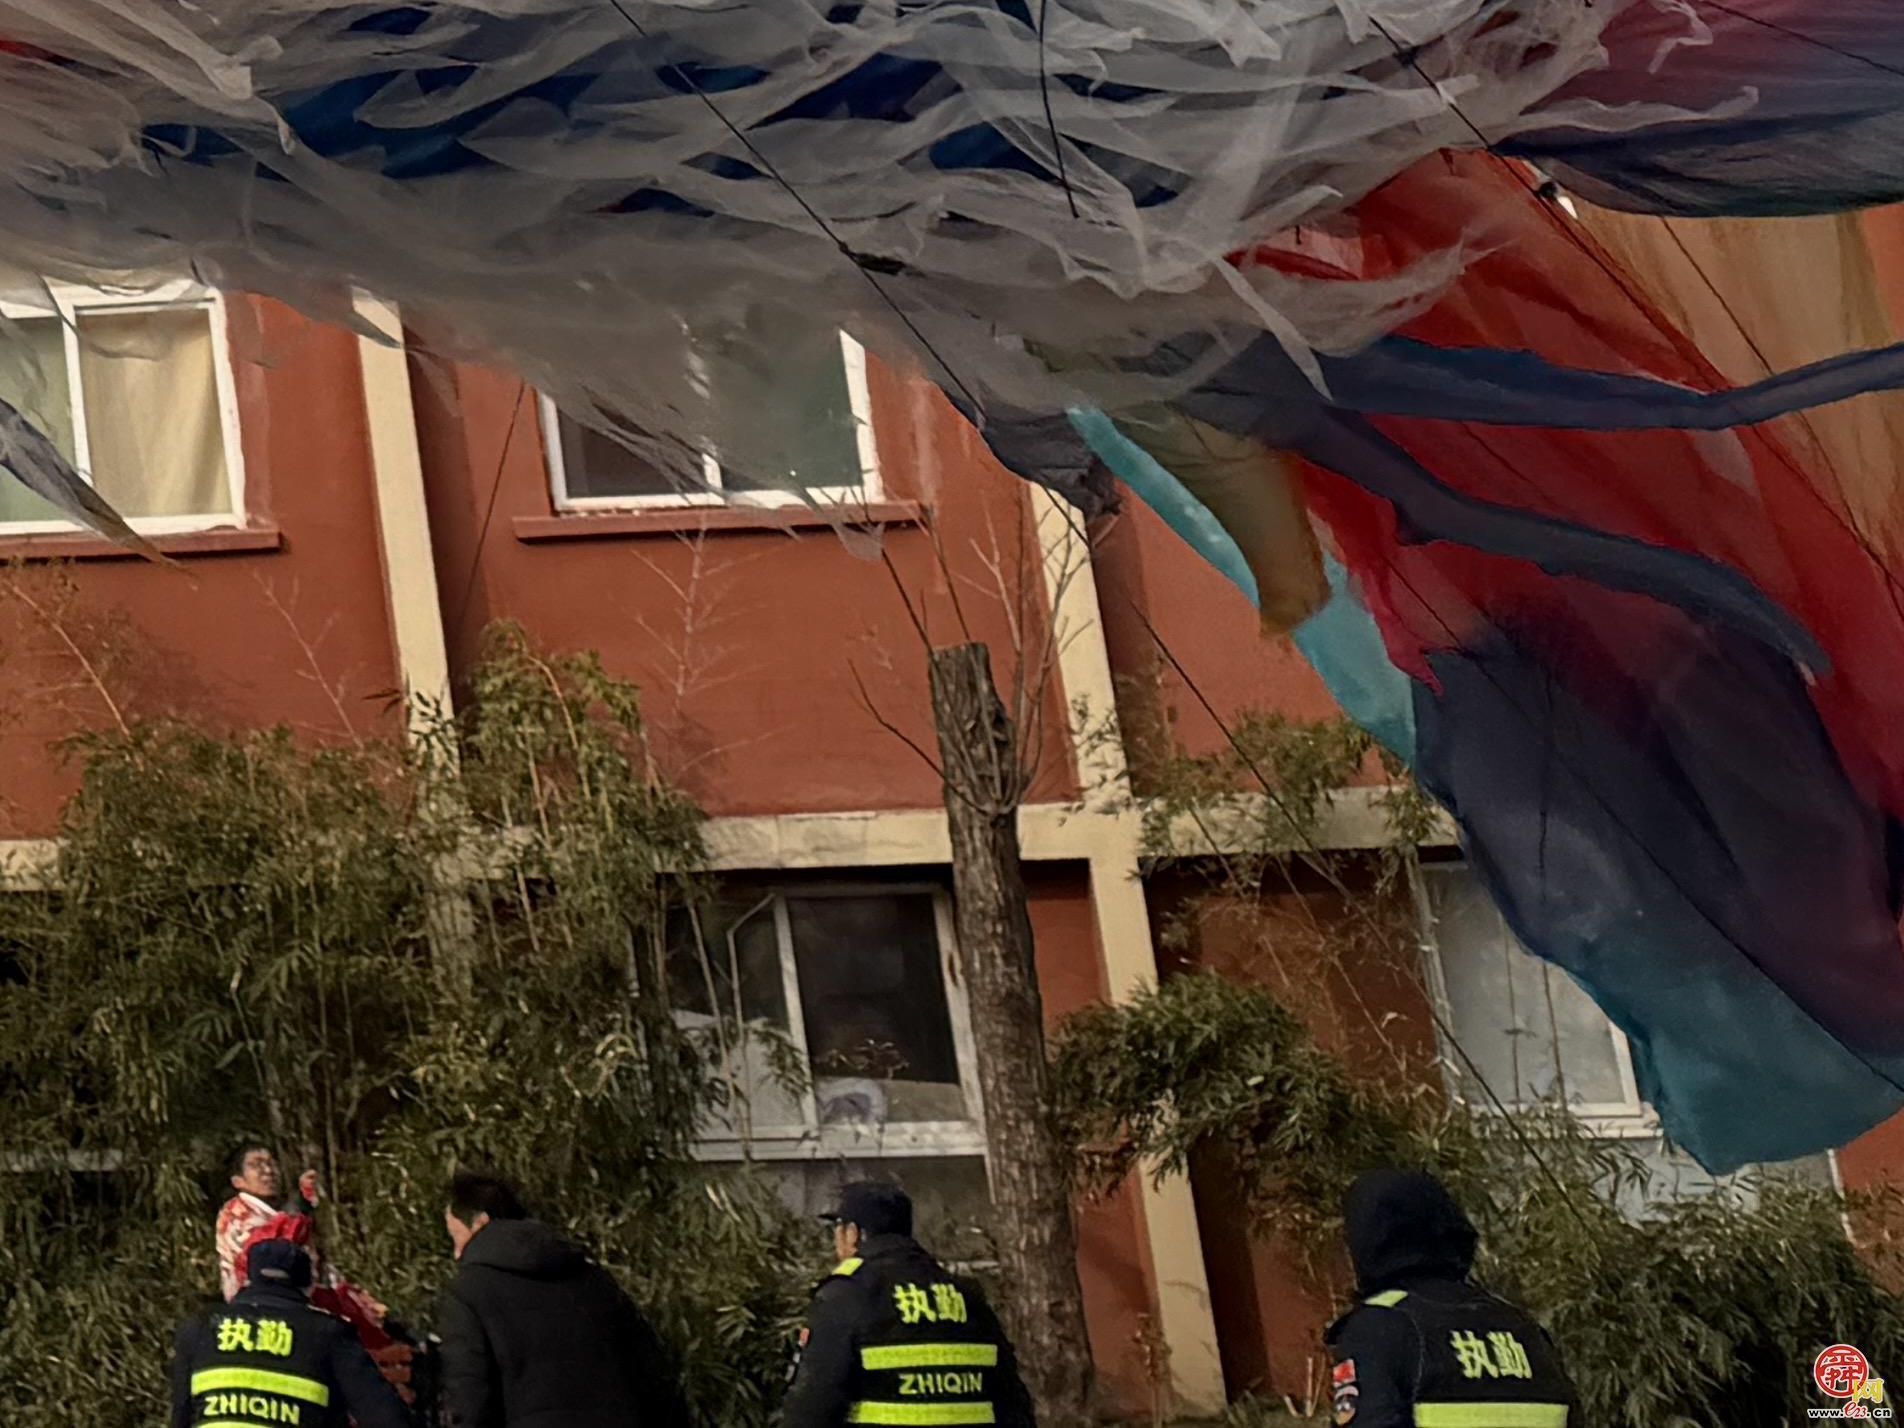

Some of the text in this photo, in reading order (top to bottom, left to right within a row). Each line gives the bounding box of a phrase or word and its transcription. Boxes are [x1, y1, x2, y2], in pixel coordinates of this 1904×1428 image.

[894, 1283, 967, 1323] 执勤
[217, 1318, 293, 1356] 执勤
[1450, 1330, 1532, 1379] 执勤
[898, 1372, 982, 1395] ZHIQIN
[203, 1393, 300, 1425] ZHIQIN
